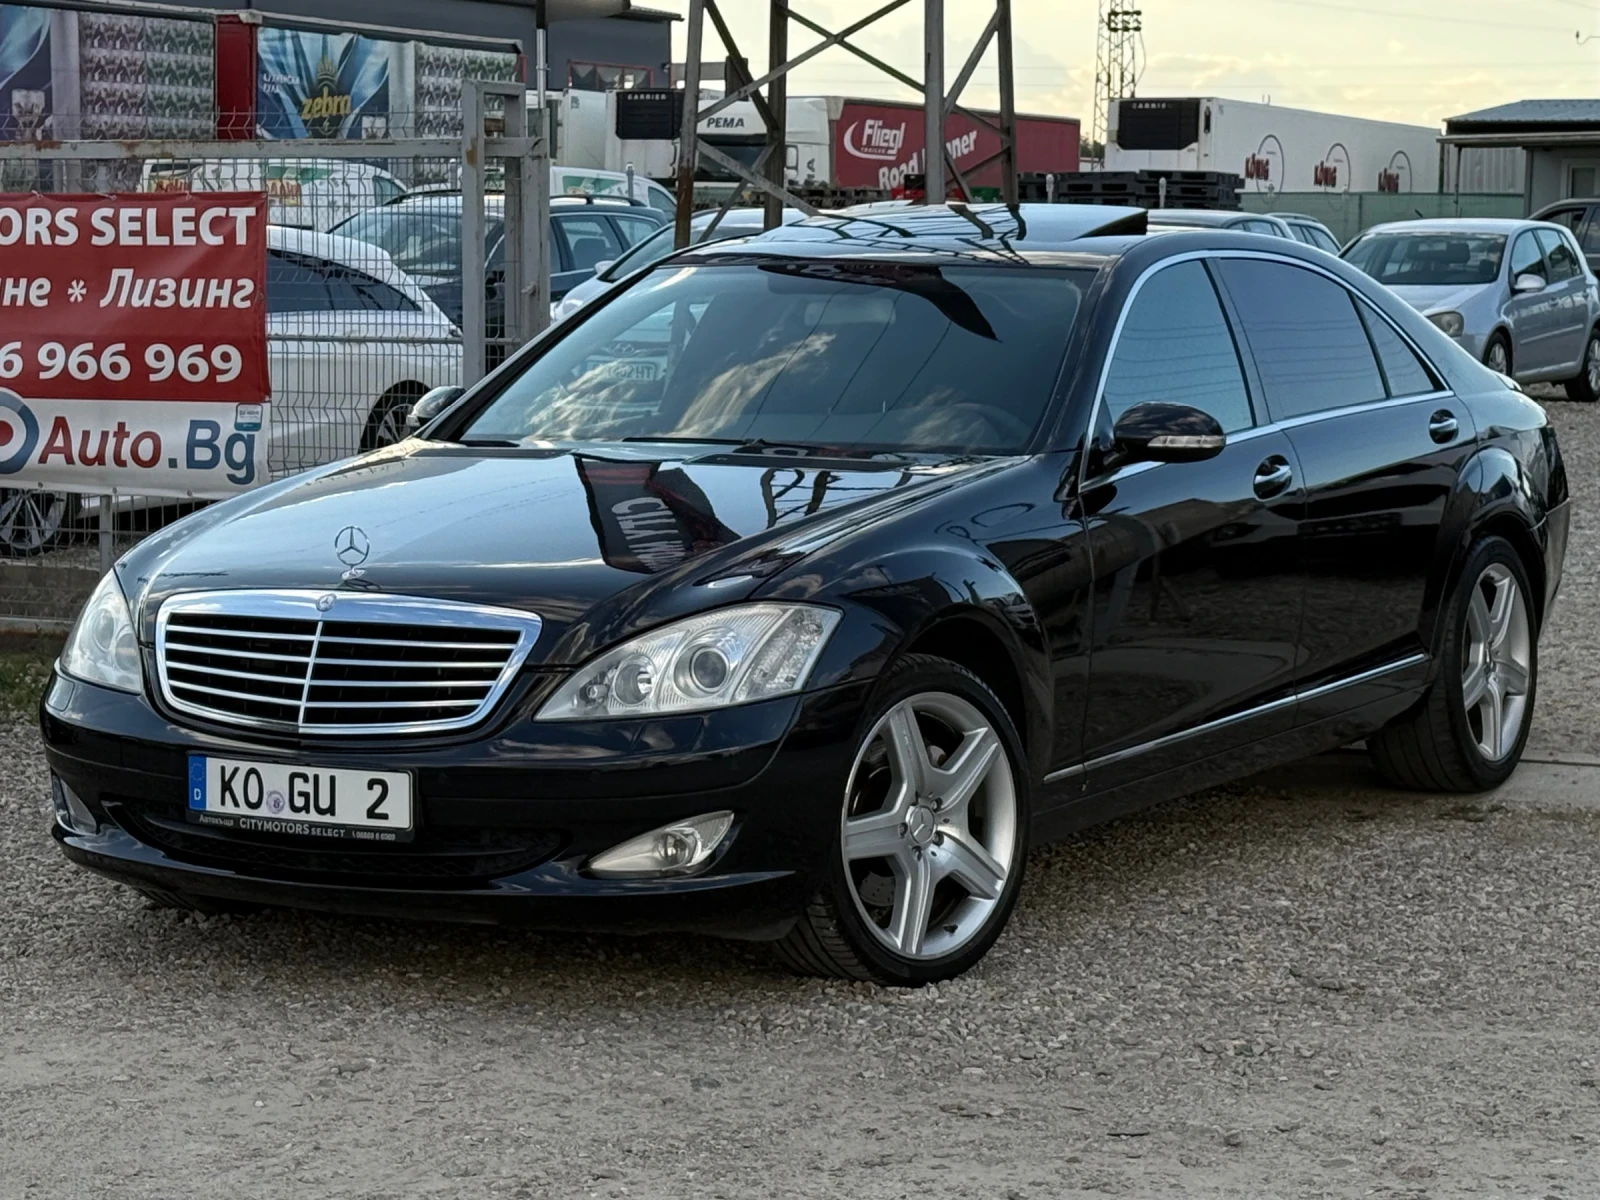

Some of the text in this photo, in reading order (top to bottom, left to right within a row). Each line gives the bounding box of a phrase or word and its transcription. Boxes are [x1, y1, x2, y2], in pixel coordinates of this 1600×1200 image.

[706, 117, 745, 129] PEMA
[862, 119, 906, 155] Fliegl
[878, 152, 919, 190] Road
[0, 206, 257, 247] ORS SELECT
[0, 267, 256, 309] не Лизинг
[0, 341, 243, 383] 6 966 969
[38, 415, 256, 485] Auto.Bg
[193, 764, 390, 821] D KO GU 2
[239, 818, 310, 836] CITYMOTORS
[311, 827, 346, 838] SELECT
